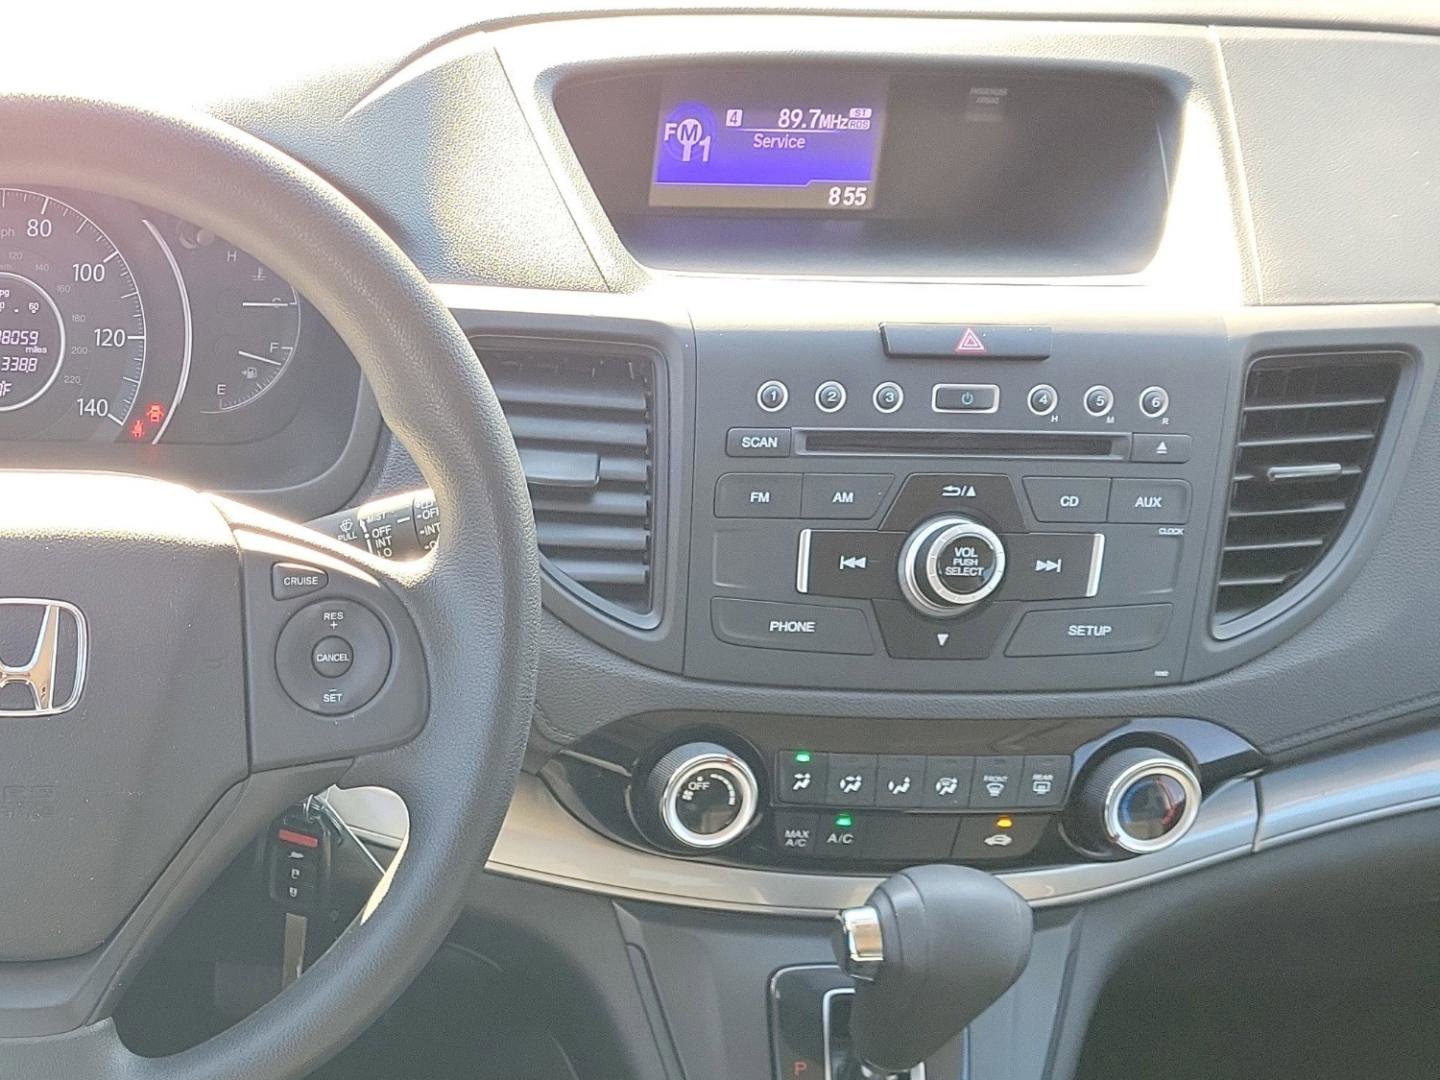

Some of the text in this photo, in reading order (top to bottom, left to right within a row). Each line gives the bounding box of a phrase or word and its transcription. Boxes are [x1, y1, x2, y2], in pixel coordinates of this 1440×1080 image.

[753, 133, 806, 149] Service
[27, 219, 52, 237] 80
[226, 251, 237, 262] H
[72, 263, 105, 282] 100
[28, 302, 39, 311] 60
[94, 328, 126, 347] 120
[25, 345, 48, 354] miles
[71, 346, 88, 354] 200
[269, 343, 278, 353] F
[216, 384, 227, 395] E
[769, 391, 778, 401] 1
[826, 391, 837, 402] 2
[885, 391, 895, 403] 3
[1039, 395, 1048, 405] 4
[1096, 396, 1105, 406] 5
[77, 399, 109, 417] 140
[1151, 397, 1160, 408] 6
[1162, 417, 1170, 425] R
[741, 436, 778, 448] SCAN
[750, 492, 769, 503] FM
[832, 492, 853, 503] AM
[1060, 495, 1079, 506] CD
[1135, 496, 1162, 508] AUX
[338, 531, 358, 541] PULL
[371, 525, 392, 539] OFF
[1158, 528, 1184, 536] CLOCK
[375, 535, 392, 548] INT
[954, 547, 978, 558] VOL
[953, 558, 978, 567] PUSH
[944, 566, 984, 577] SELECT
[283, 576, 319, 586] CRUISE
[323, 611, 344, 621] RES
[769, 621, 815, 633] PHONE
[1068, 625, 1112, 636] SETUP
[316, 653, 350, 662] CANCEL
[322, 693, 343, 703] SET
[688, 781, 711, 791] OFF
[784, 829, 810, 839] MAX
[825, 833, 854, 845] A/C
[785, 838, 807, 848] A/C
[794, 1062, 808, 1076] P
